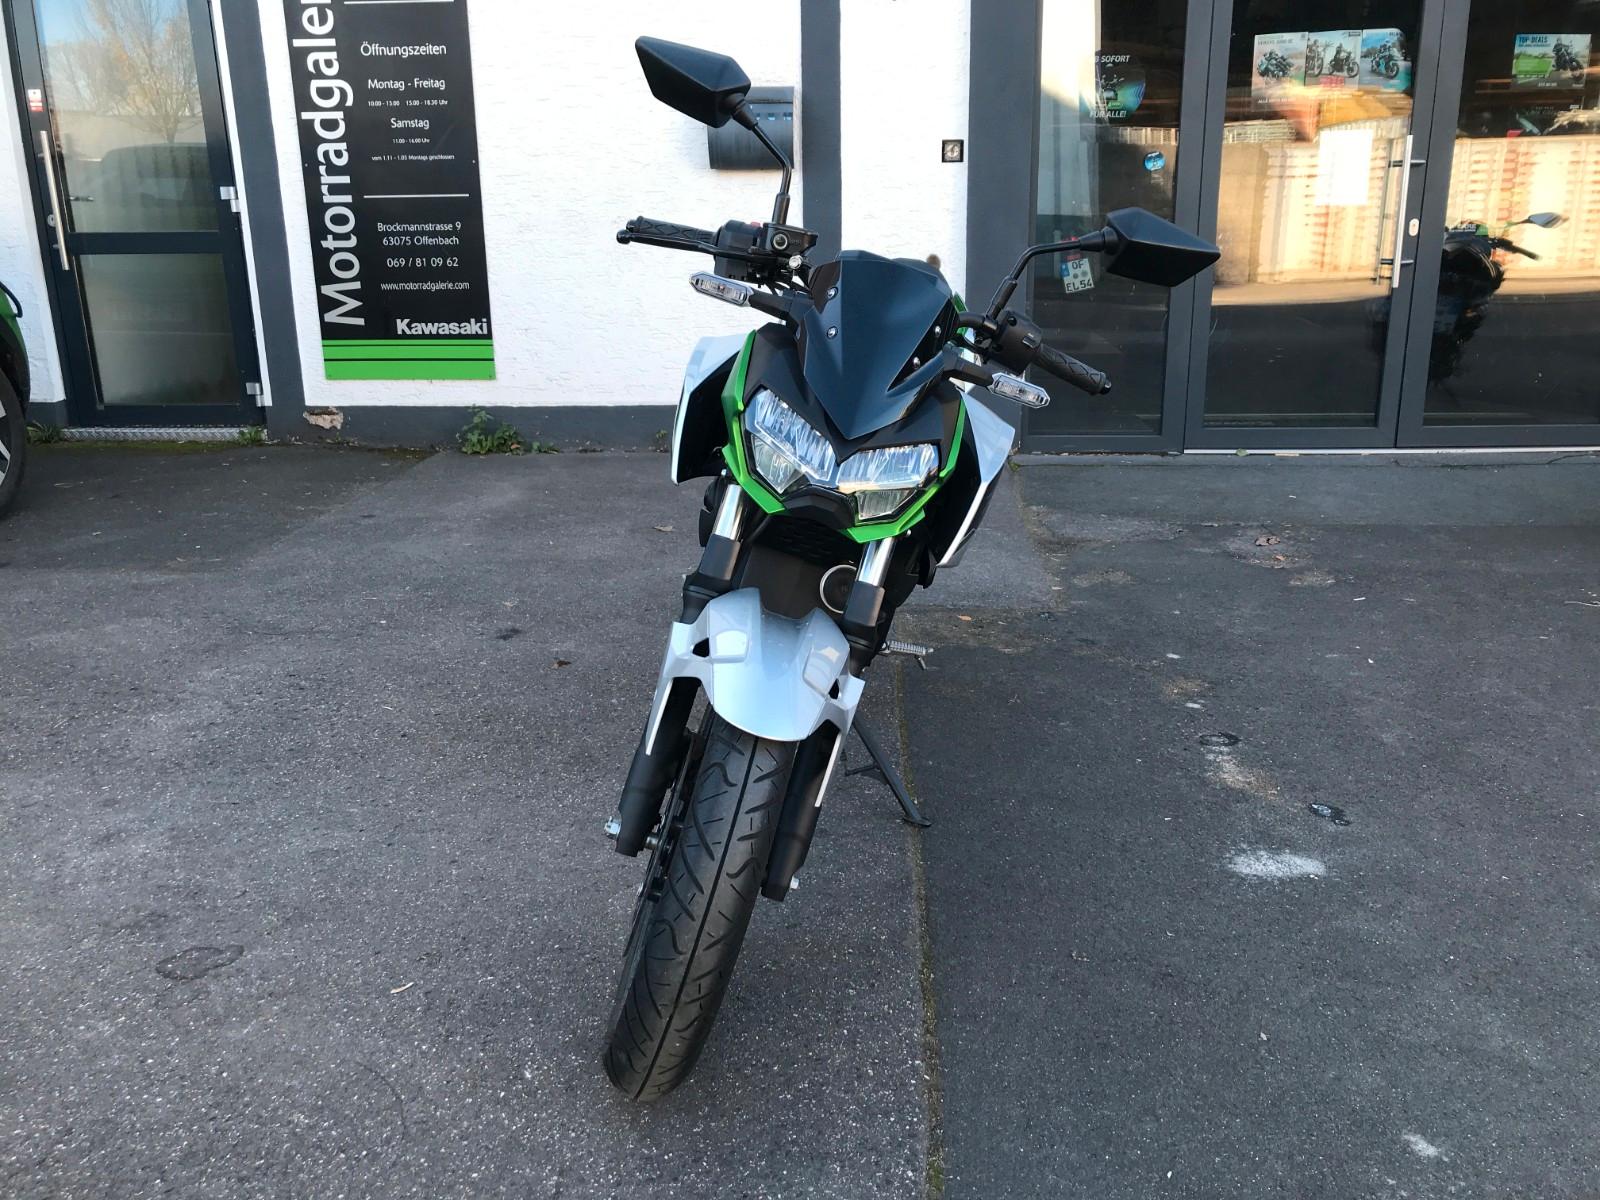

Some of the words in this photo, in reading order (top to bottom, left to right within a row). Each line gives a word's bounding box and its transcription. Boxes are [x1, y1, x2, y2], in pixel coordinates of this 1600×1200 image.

[360, 41, 447, 58] Öffnungszeiten
[1101, 55, 1130, 63] SOFORT
[368, 79, 405, 91] Montag
[414, 78, 446, 90] Freitag
[1107, 110, 1127, 118] ALLE!
[391, 117, 430, 130] Samstag
[292, 0, 365, 325] Motorradgale
[377, 222, 453, 232] Brockmannstrasse
[455, 221, 462, 231] 9
[382, 236, 412, 246] 63075
[414, 235, 460, 246] Offenbach
[386, 257, 406, 267] 069
[415, 257, 427, 267] 81
[430, 257, 443, 267] 09
[446, 257, 459, 267] 62
[1071, 260, 1084, 270] OF
[380, 281, 470, 292] www.motorradgalerie.com
[396, 318, 488, 335] Kawasaki
